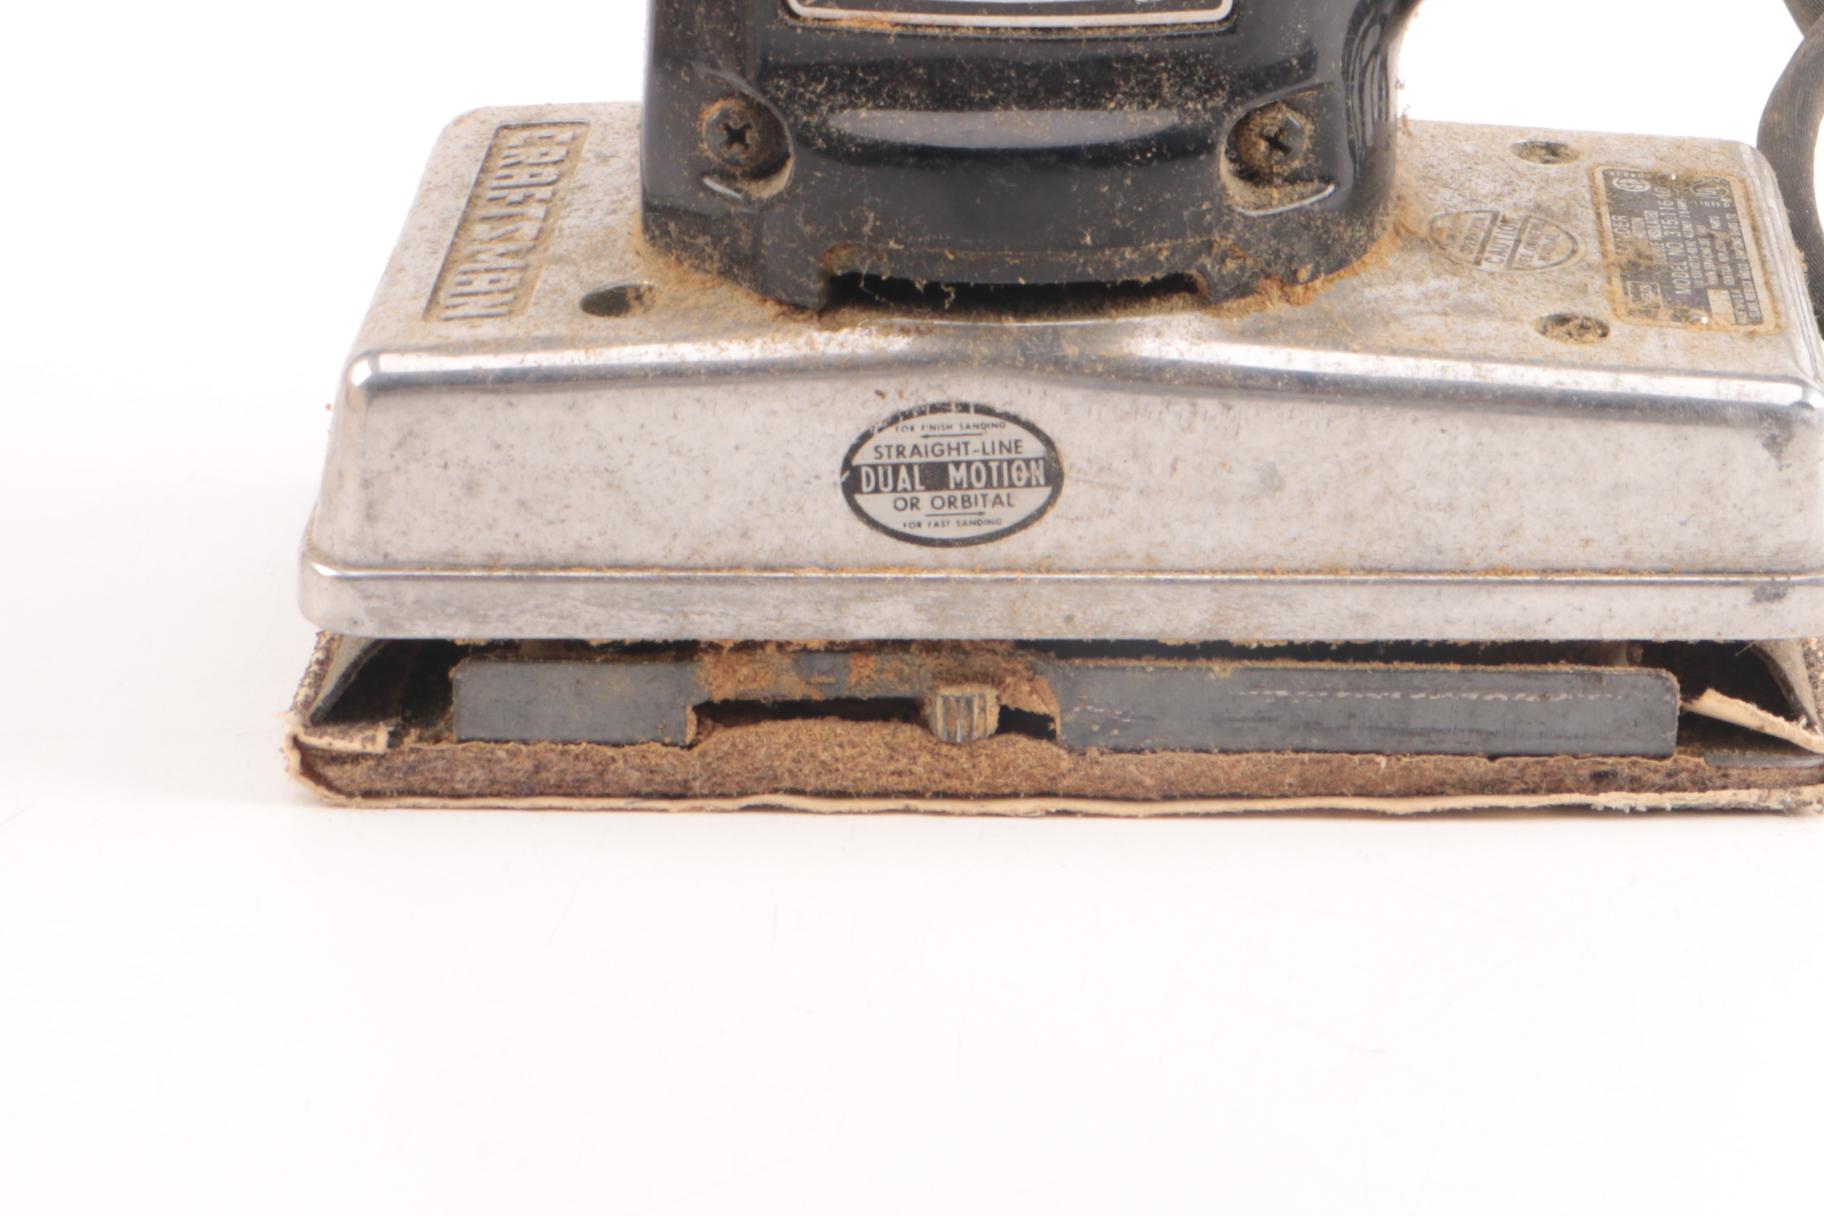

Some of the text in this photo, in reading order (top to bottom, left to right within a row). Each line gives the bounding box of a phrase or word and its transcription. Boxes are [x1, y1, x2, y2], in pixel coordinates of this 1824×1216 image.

[441, 131, 577, 321] CRAFTSMAN
[1670, 260, 1692, 296] MODEL
[895, 421, 1007, 433] FOR FINISH SANDING
[873, 439, 1024, 461] STRAIGHT-LINE
[860, 458, 1046, 494] DUAL MOTION
[893, 492, 1016, 512] OR ORBITAL
[903, 518, 1003, 530] FOR FAST SANDING
